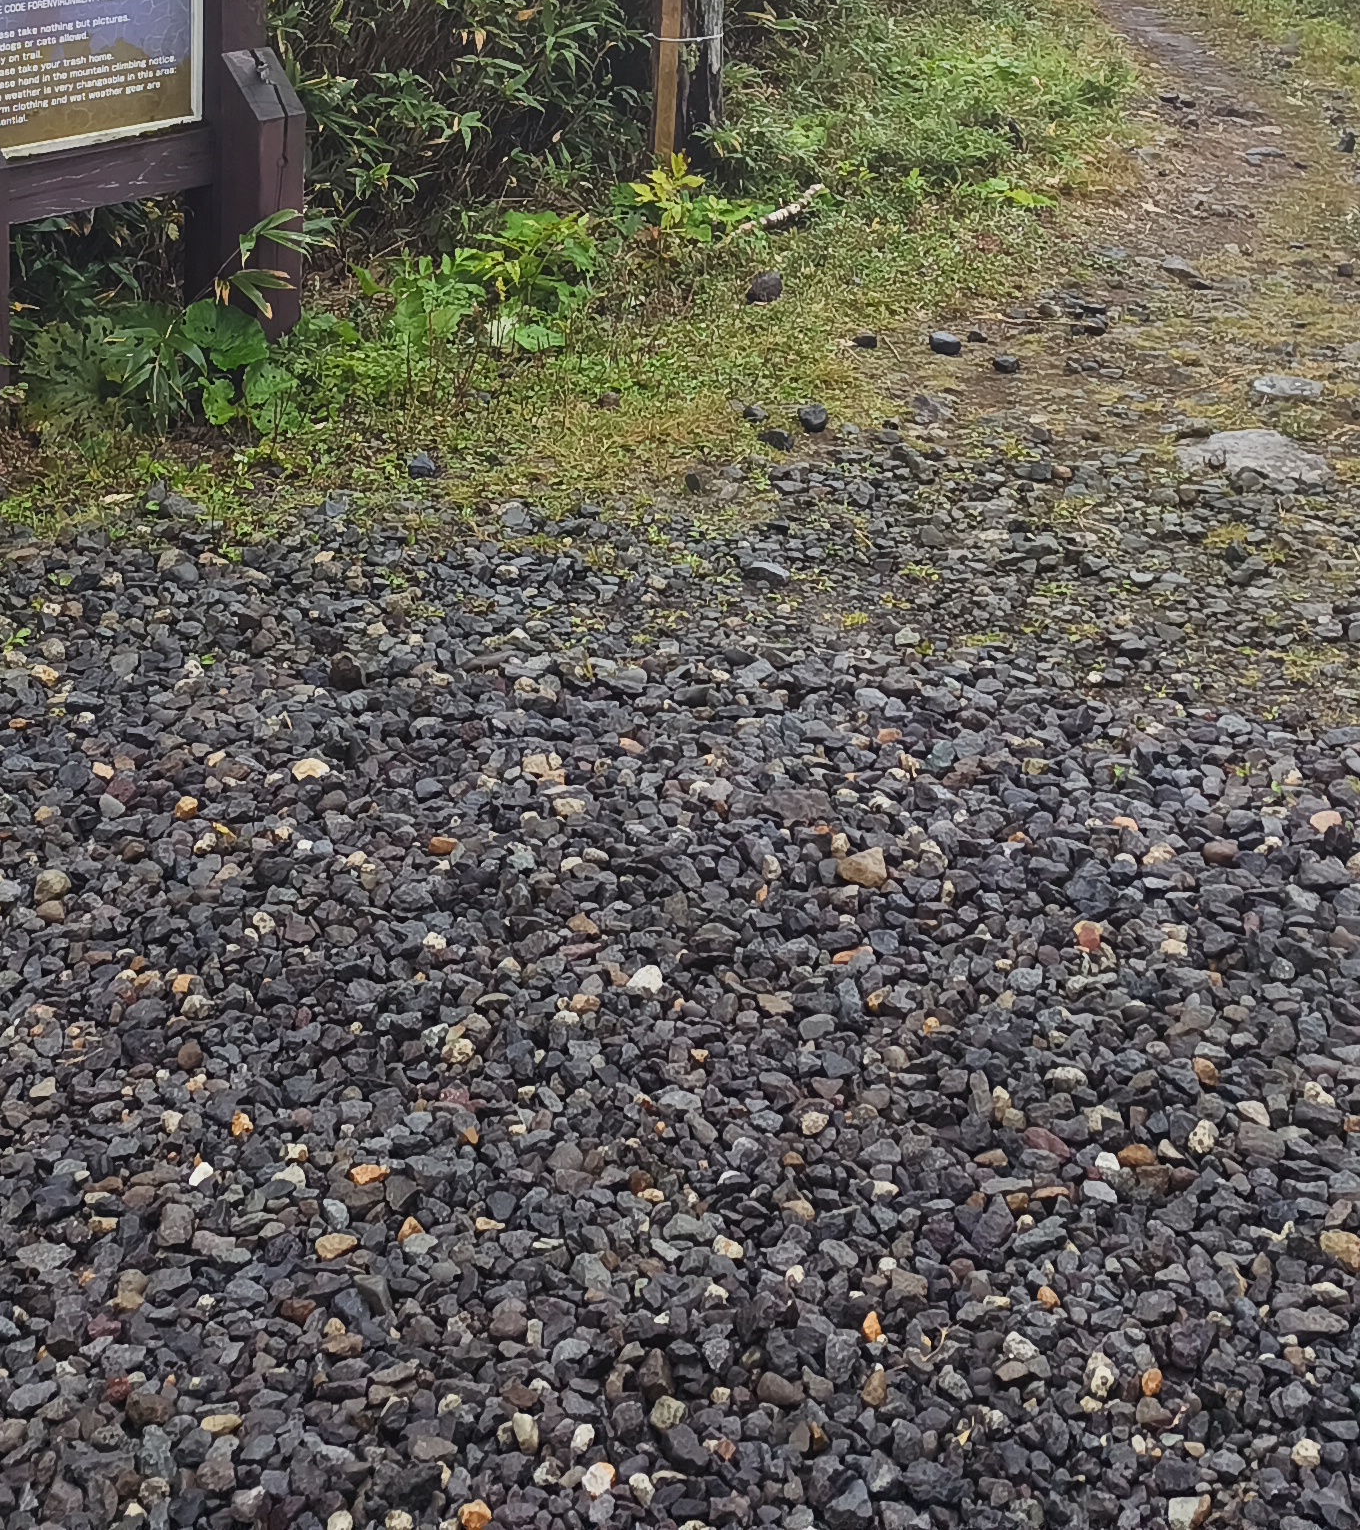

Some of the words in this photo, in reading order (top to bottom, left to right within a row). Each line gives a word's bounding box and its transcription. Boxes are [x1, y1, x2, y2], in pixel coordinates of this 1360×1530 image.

[4, 2, 26, 14] CODE
[18, 27, 38, 36] take
[40, 22, 74, 34] nothing
[75, 18, 90, 28] but
[92, 14, 130, 26] pictures.
[0, 41, 22, 53] dogs
[24, 40, 35, 48] or
[36, 37, 57, 46] cats
[9, 54, 19, 62] on
[22, 50, 43, 61] trail.
[18, 64, 39, 74] take
[41, 61, 61, 72] your
[63, 56, 86, 67] trash
[89, 52, 115, 63] home.
[18, 76, 39, 86] hand
[42, 73, 50, 82] in
[53, 71, 67, 81] the
[69, 64, 109, 78] mountain
[111, 58, 146, 72] climbing
[149, 54, 177, 65] notice.
[4, 87, 41, 101] weather
[43, 86, 52, 95] is
[54, 83, 74, 94] very
[76, 73, 125, 90] changeable
[127, 72, 136, 81] in
[138, 69, 154, 79] this
[12, 98, 49, 112] clothing
[51, 95, 68, 106] and
[70, 92, 86, 102] wet
[88, 86, 123, 100] weather
[125, 82, 145, 95] gear
[147, 81, 161, 90] are
